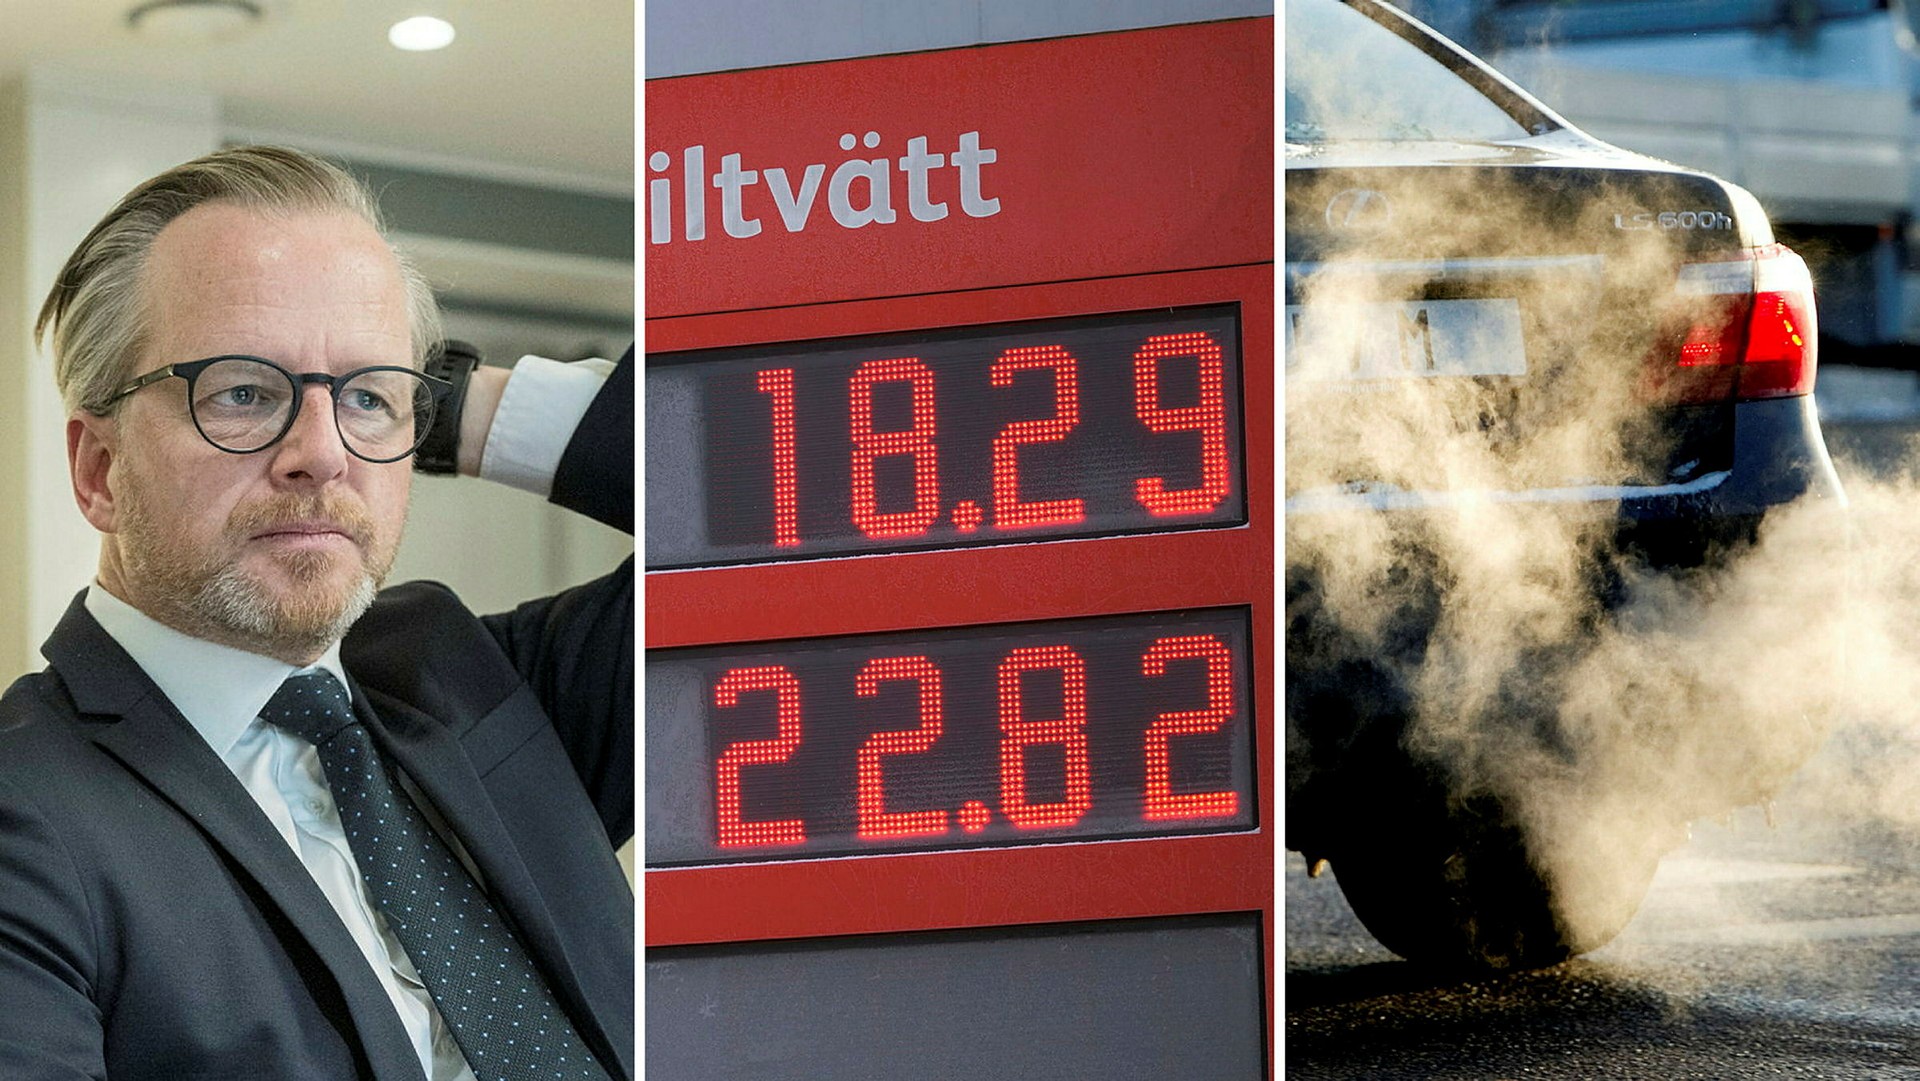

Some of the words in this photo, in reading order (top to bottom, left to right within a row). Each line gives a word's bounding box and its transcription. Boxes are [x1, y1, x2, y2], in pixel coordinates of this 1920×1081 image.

[650, 131, 1001, 244] iltvätt
[1614, 212, 1651, 231] LS
[1657, 211, 1732, 231] 600h
[757, 332, 1229, 548] 18.29
[715, 634, 1239, 848] 22.82
